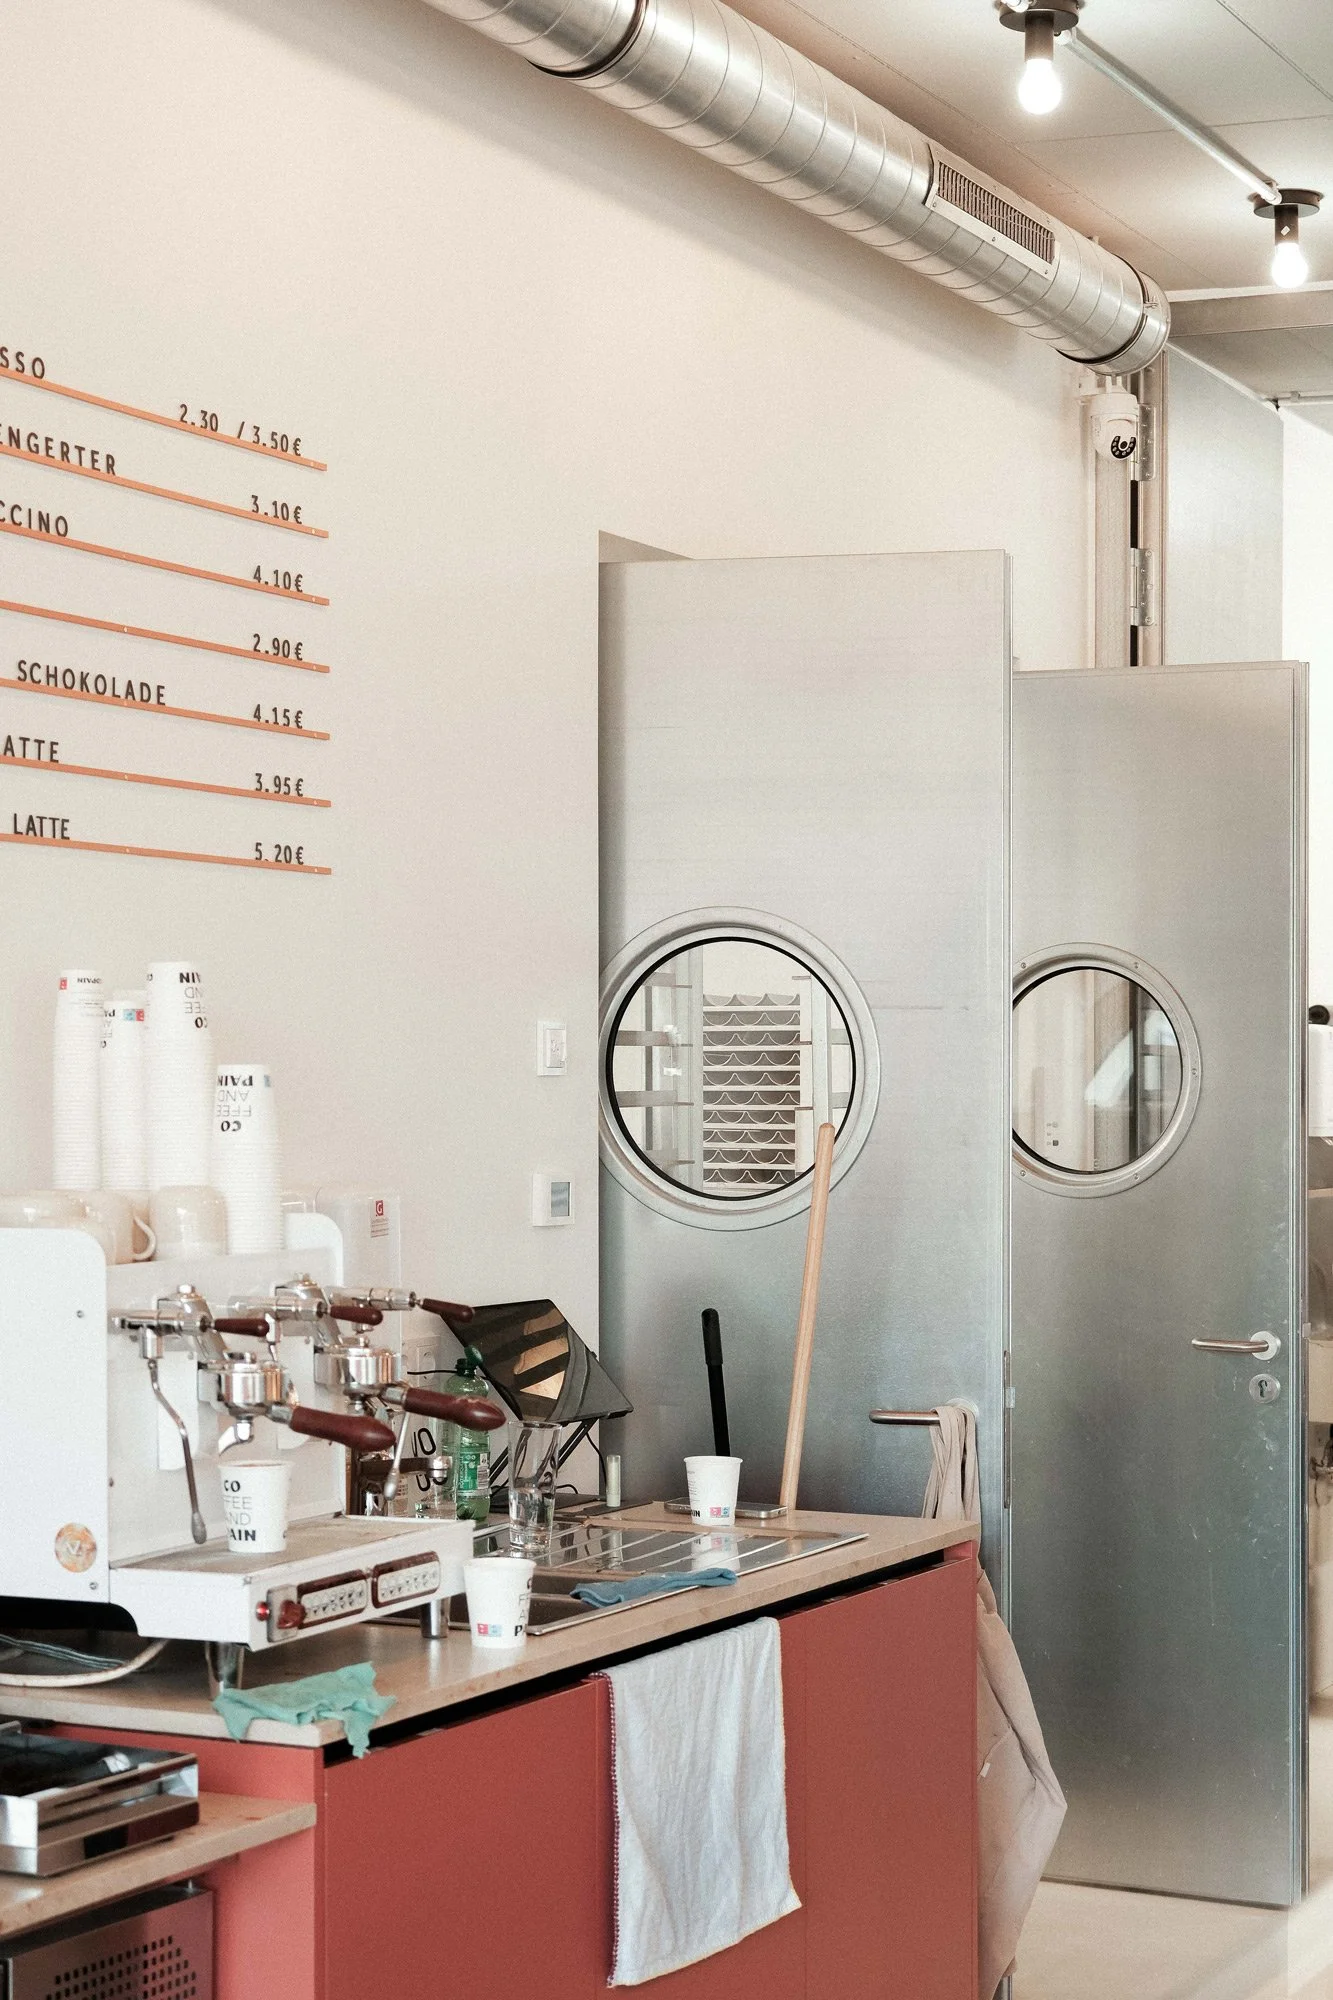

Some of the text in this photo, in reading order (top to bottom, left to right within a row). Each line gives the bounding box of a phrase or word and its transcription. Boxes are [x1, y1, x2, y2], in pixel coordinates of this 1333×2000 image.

[179, 403, 219, 432] 2.30
[0, 424, 116, 476] NGERTER
[251, 494, 303, 525] 3.10€
[253, 565, 303, 593] 4.10€
[253, 633, 303, 661] 2.90€
[17, 659, 166, 706] SCHOKOLADE
[253, 703, 303, 730] 4.15€
[3, 734, 59, 764] ATTE
[255, 772, 304, 798] 3.95€
[13, 812, 70, 841] LATTE
[255, 842, 304, 866] 5.20€
[220, 1120, 242, 1132] CO
